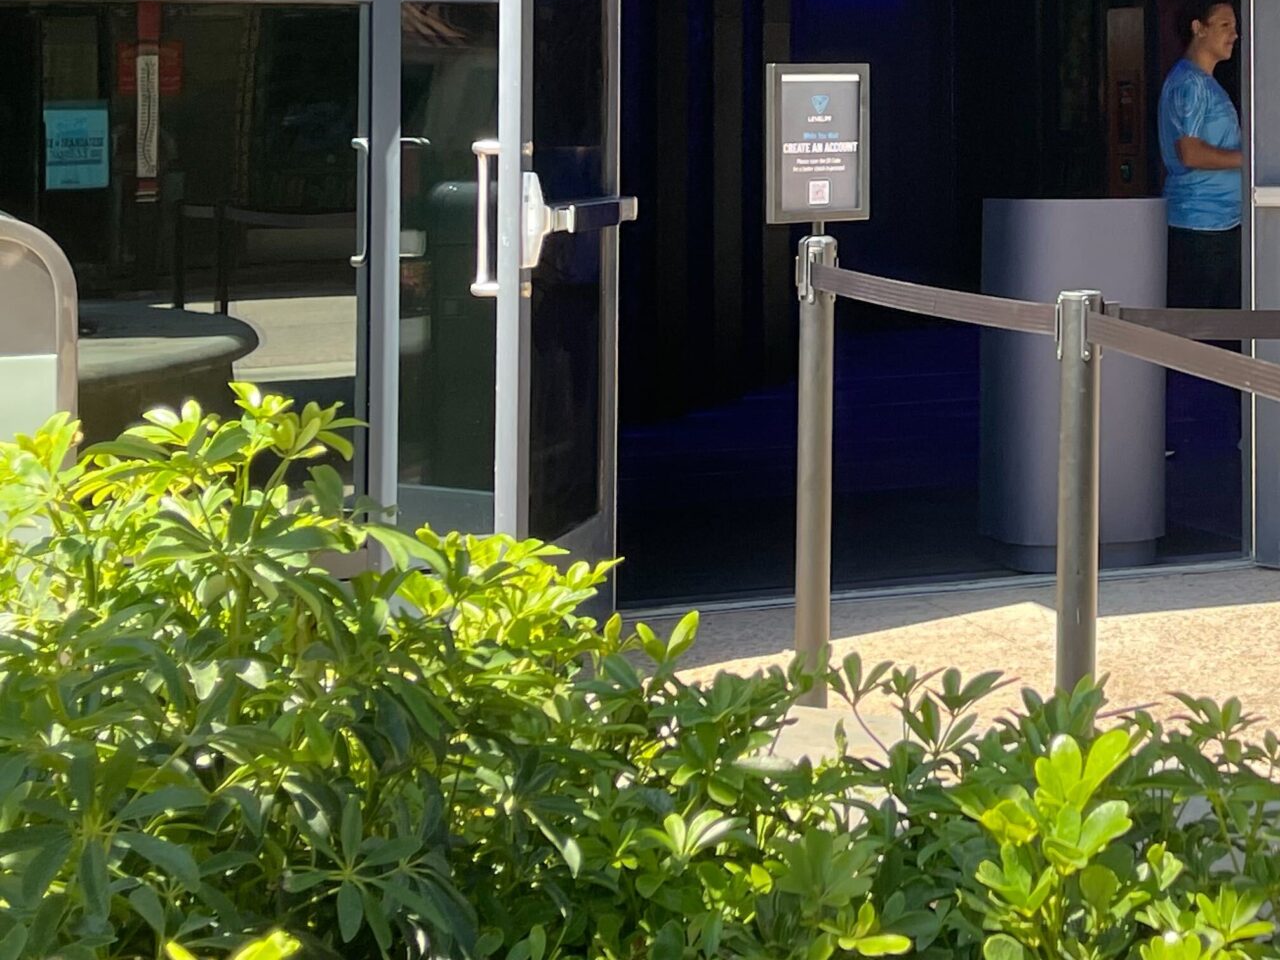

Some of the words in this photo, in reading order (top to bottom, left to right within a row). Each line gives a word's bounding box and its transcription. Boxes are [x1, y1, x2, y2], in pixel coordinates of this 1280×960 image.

[783, 142, 811, 154] CREATE
[812, 142, 823, 153] AN
[824, 141, 858, 153] ACCOUNT
